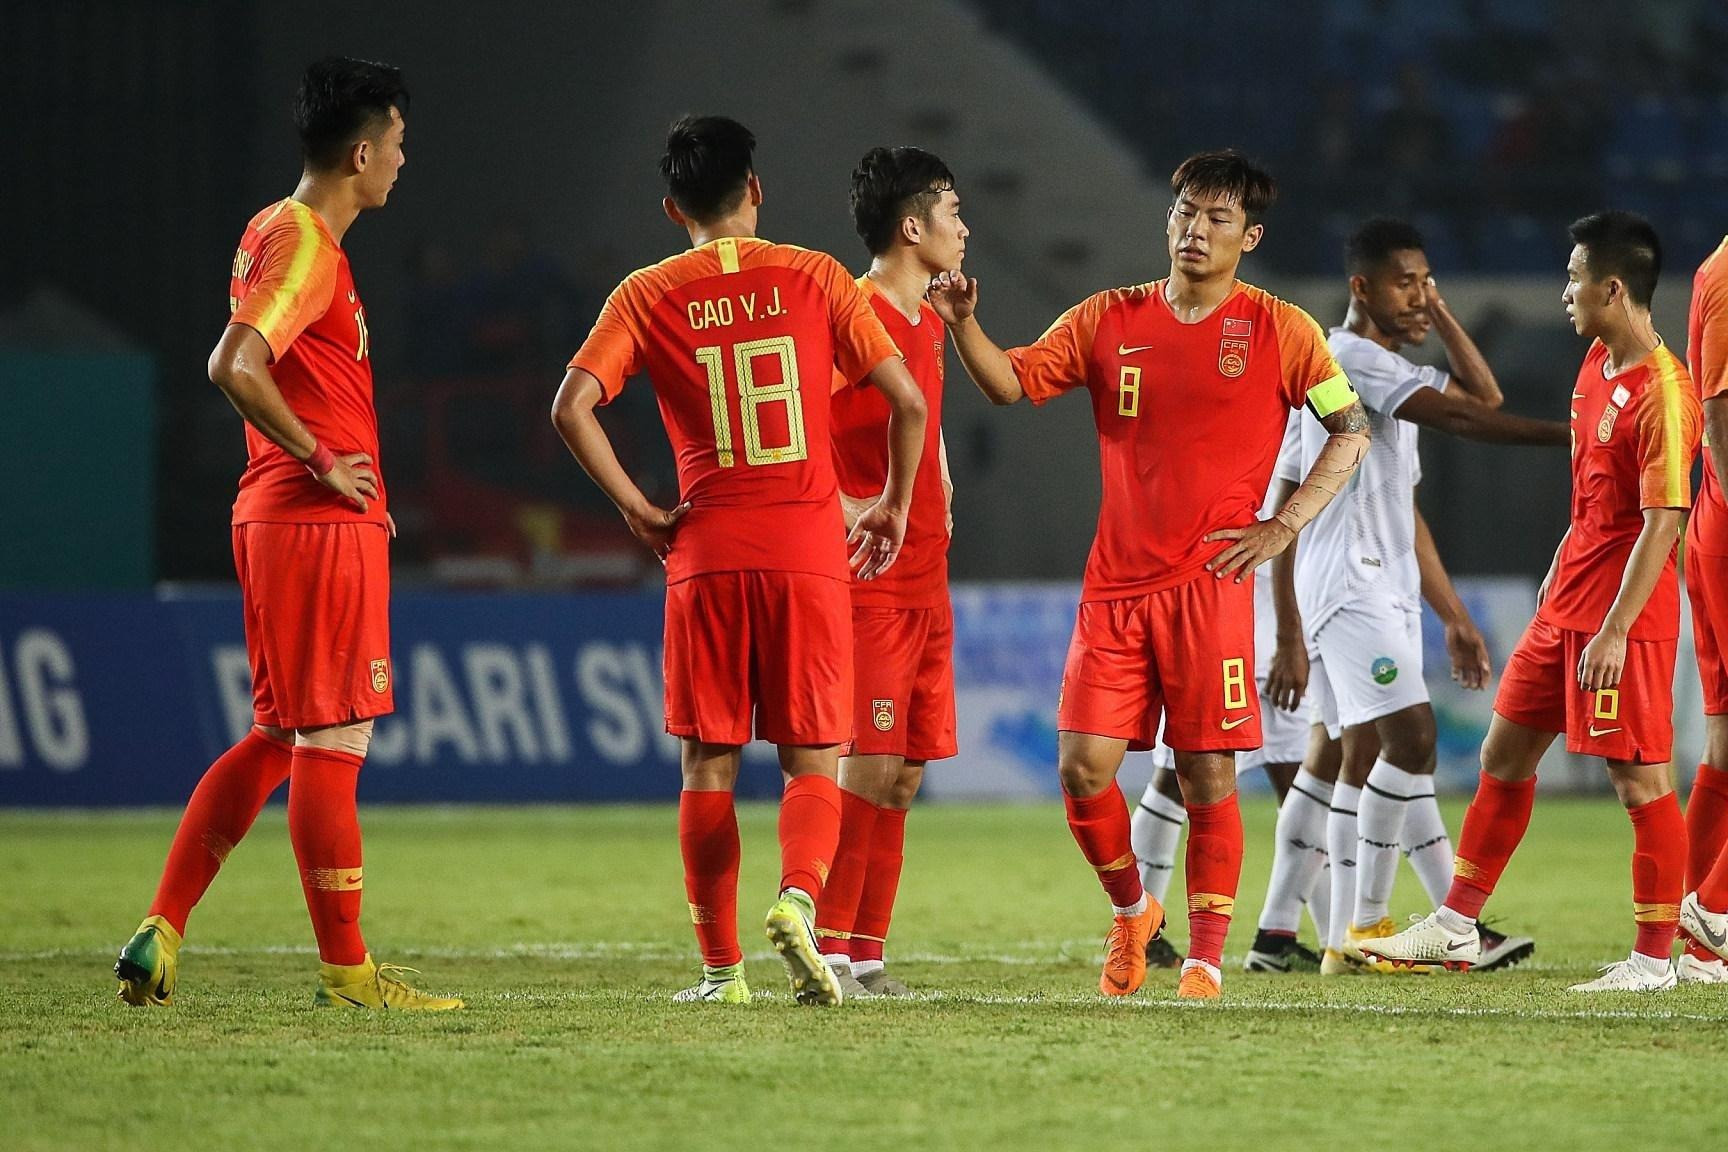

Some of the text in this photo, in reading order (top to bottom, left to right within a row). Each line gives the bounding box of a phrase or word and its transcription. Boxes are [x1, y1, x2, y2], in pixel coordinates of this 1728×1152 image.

[687, 297, 734, 330] CAO
[1223, 341, 1247, 351] CFA
[695, 335, 808, 468] 18
[1118, 365, 1142, 418] 8
[1222, 657, 1248, 710] 8
